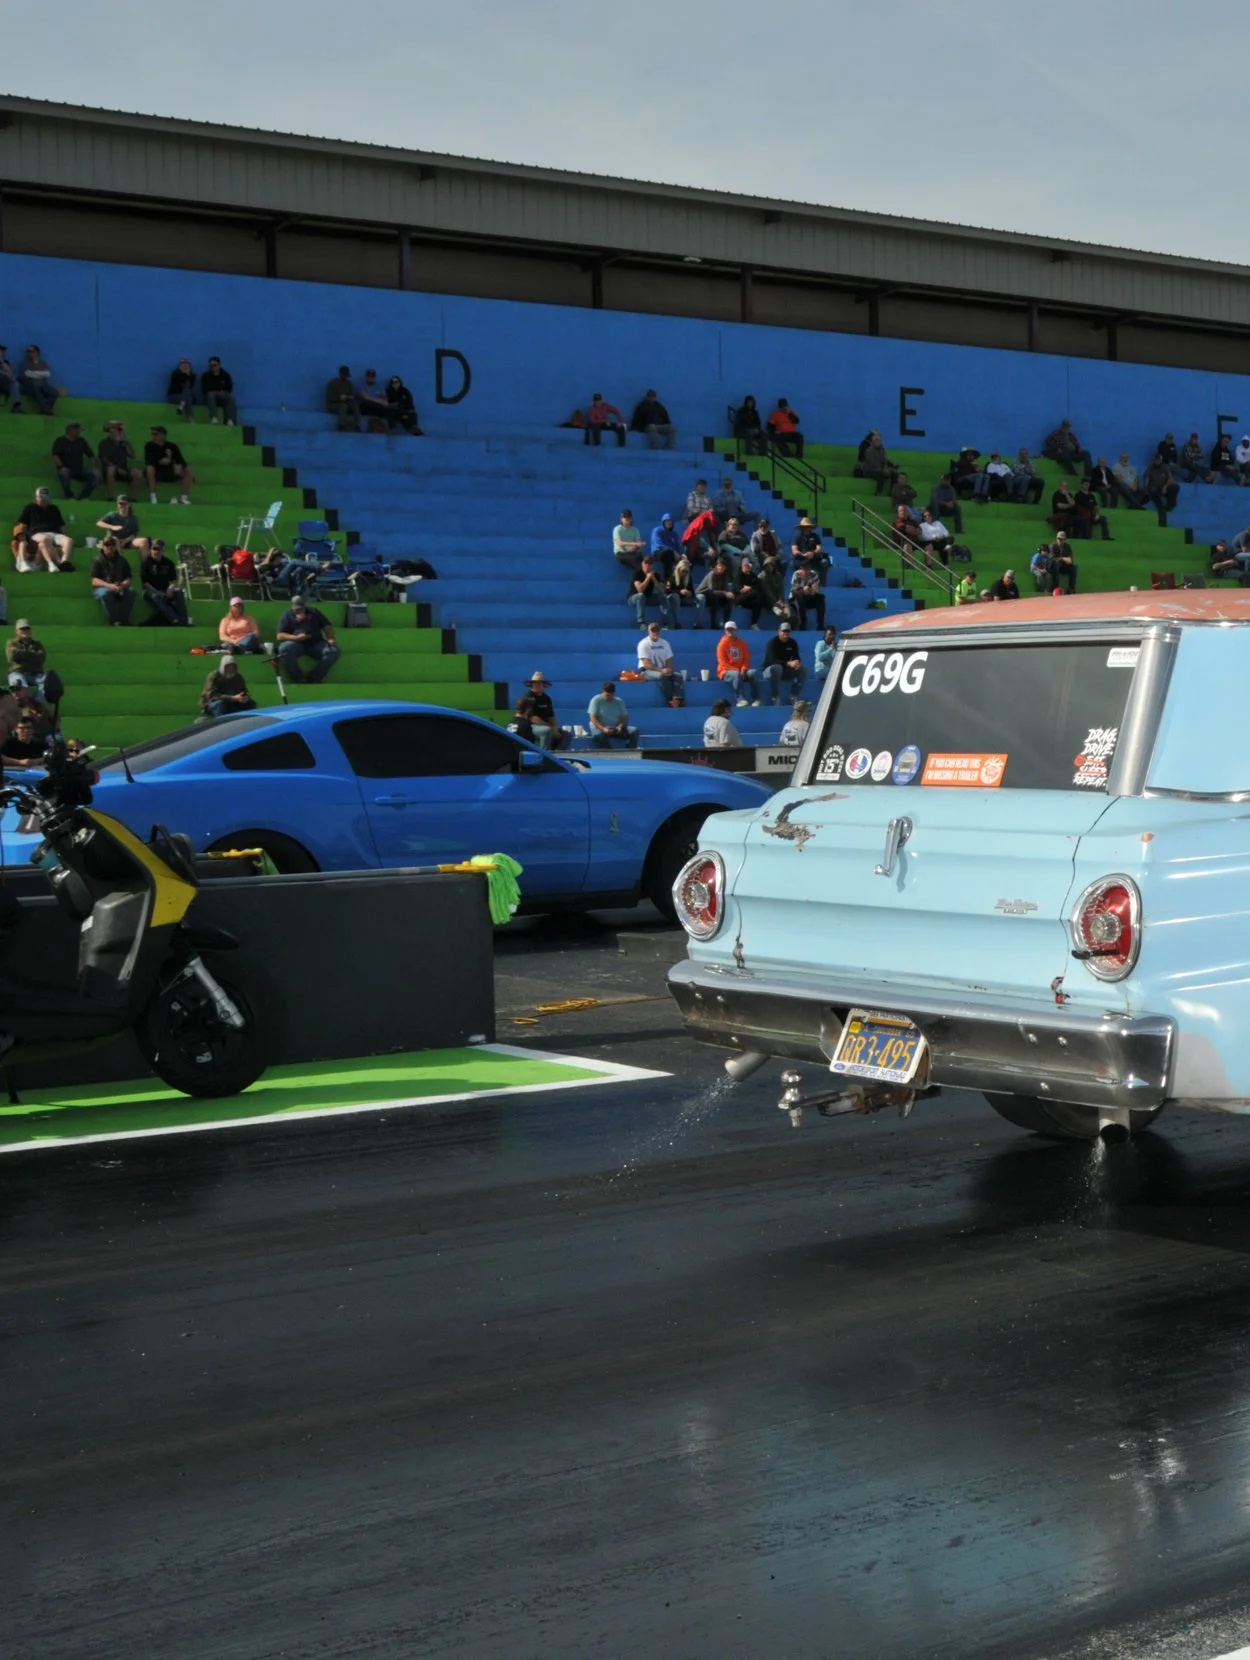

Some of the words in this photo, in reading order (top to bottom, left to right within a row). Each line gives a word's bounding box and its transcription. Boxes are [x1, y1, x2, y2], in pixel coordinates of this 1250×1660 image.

[435, 348, 471, 405] D
[900, 386, 925, 437] E
[841, 651, 929, 697] C69G
